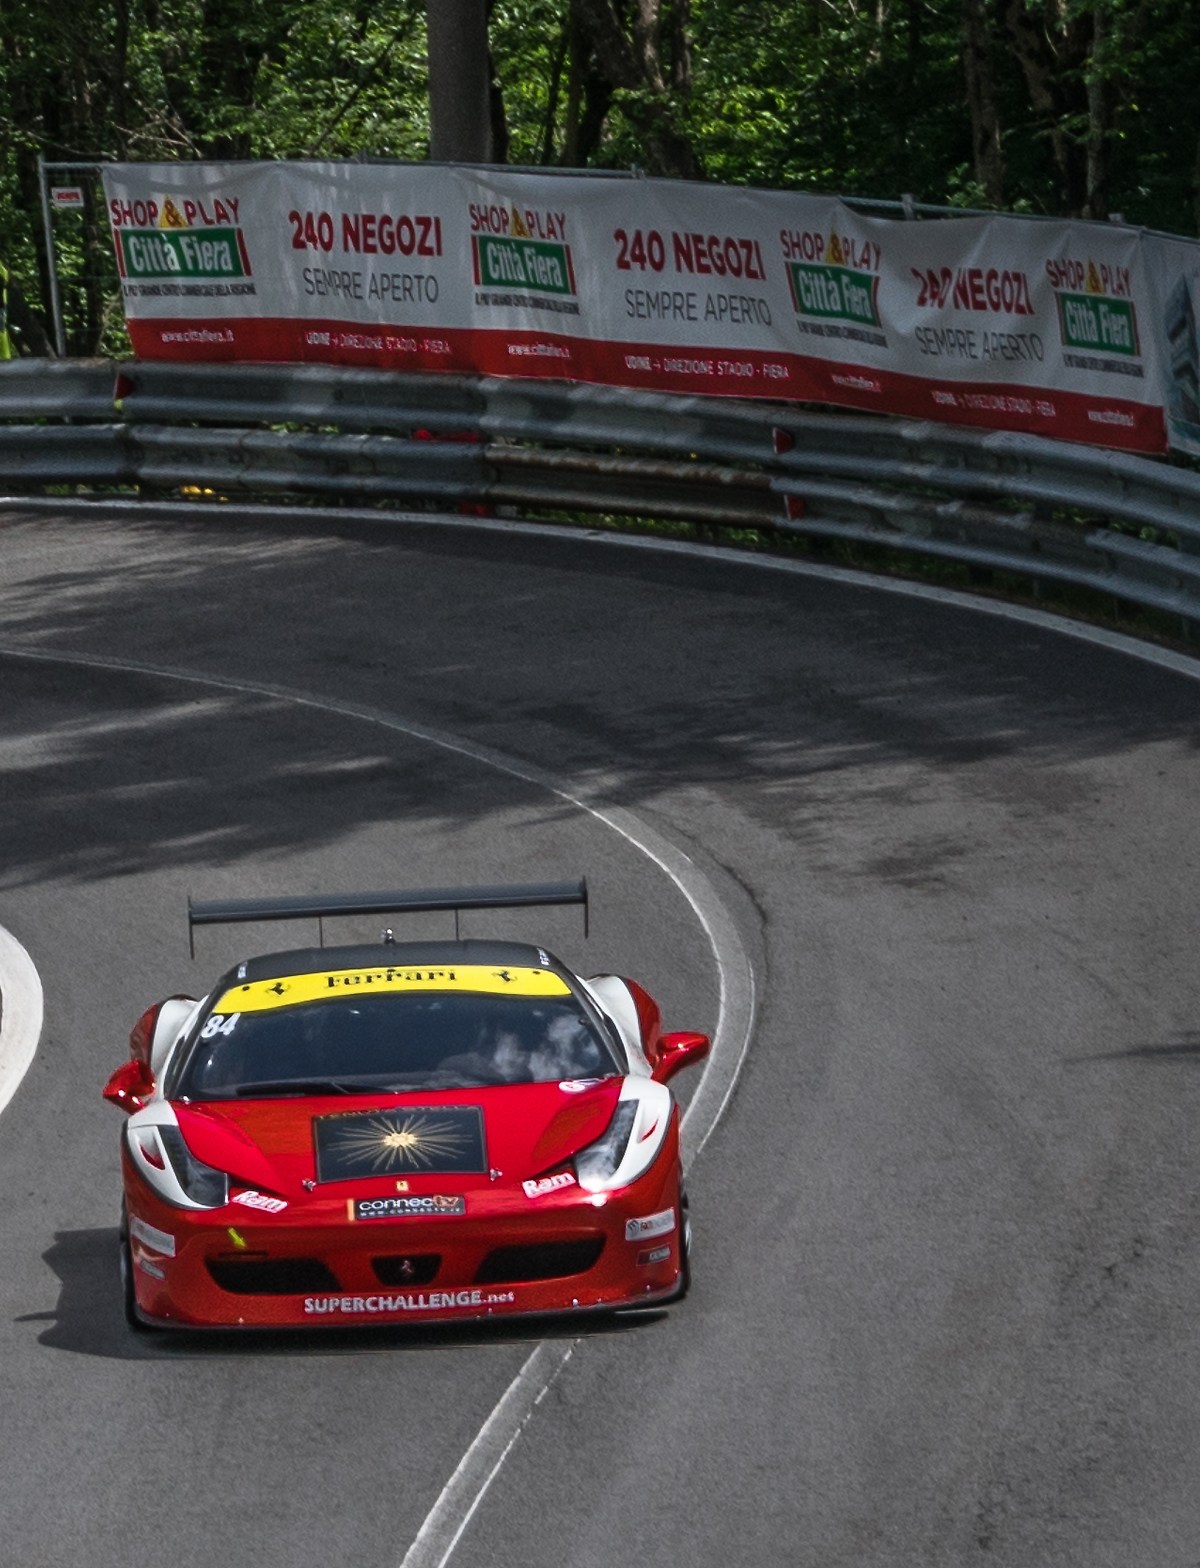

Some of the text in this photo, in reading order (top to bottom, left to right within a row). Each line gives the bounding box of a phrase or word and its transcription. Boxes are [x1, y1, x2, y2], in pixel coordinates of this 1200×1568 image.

[110, 198, 159, 226] SHOP
[183, 198, 240, 226] PLAY
[468, 203, 510, 234] SHOP
[525, 210, 567, 241] PLAY
[128, 232, 234, 272] Città Fiera
[288, 210, 443, 257] 240 NEGOZI
[780, 229, 825, 261] SHOP
[842, 236, 882, 271] PLAY
[486, 241, 564, 288] Città Fiera
[613, 228, 767, 281] 240 NEGOZI
[302, 267, 440, 303] SEMPRE APERTO
[798, 269, 874, 319] Città Fiera
[953, 267, 1036, 316] NEGOZI
[1045, 258, 1085, 290] SHOP
[1100, 263, 1131, 297] PLAY
[624, 288, 773, 327] SEMPRE APERTO
[1065, 298, 1131, 347] Città Fiera
[914, 326, 978, 360] SEMPRE
[981, 331, 1044, 362] APERTO
[663, 357, 714, 376] DIREZIONE
[717, 360, 754, 377] STADIO
[326, 968, 458, 988] Ferrari
[201, 1012, 241, 1039] 84
[522, 1172, 577, 1199] Ram
[304, 1288, 515, 1314] SUPERCHALLENGE.net
